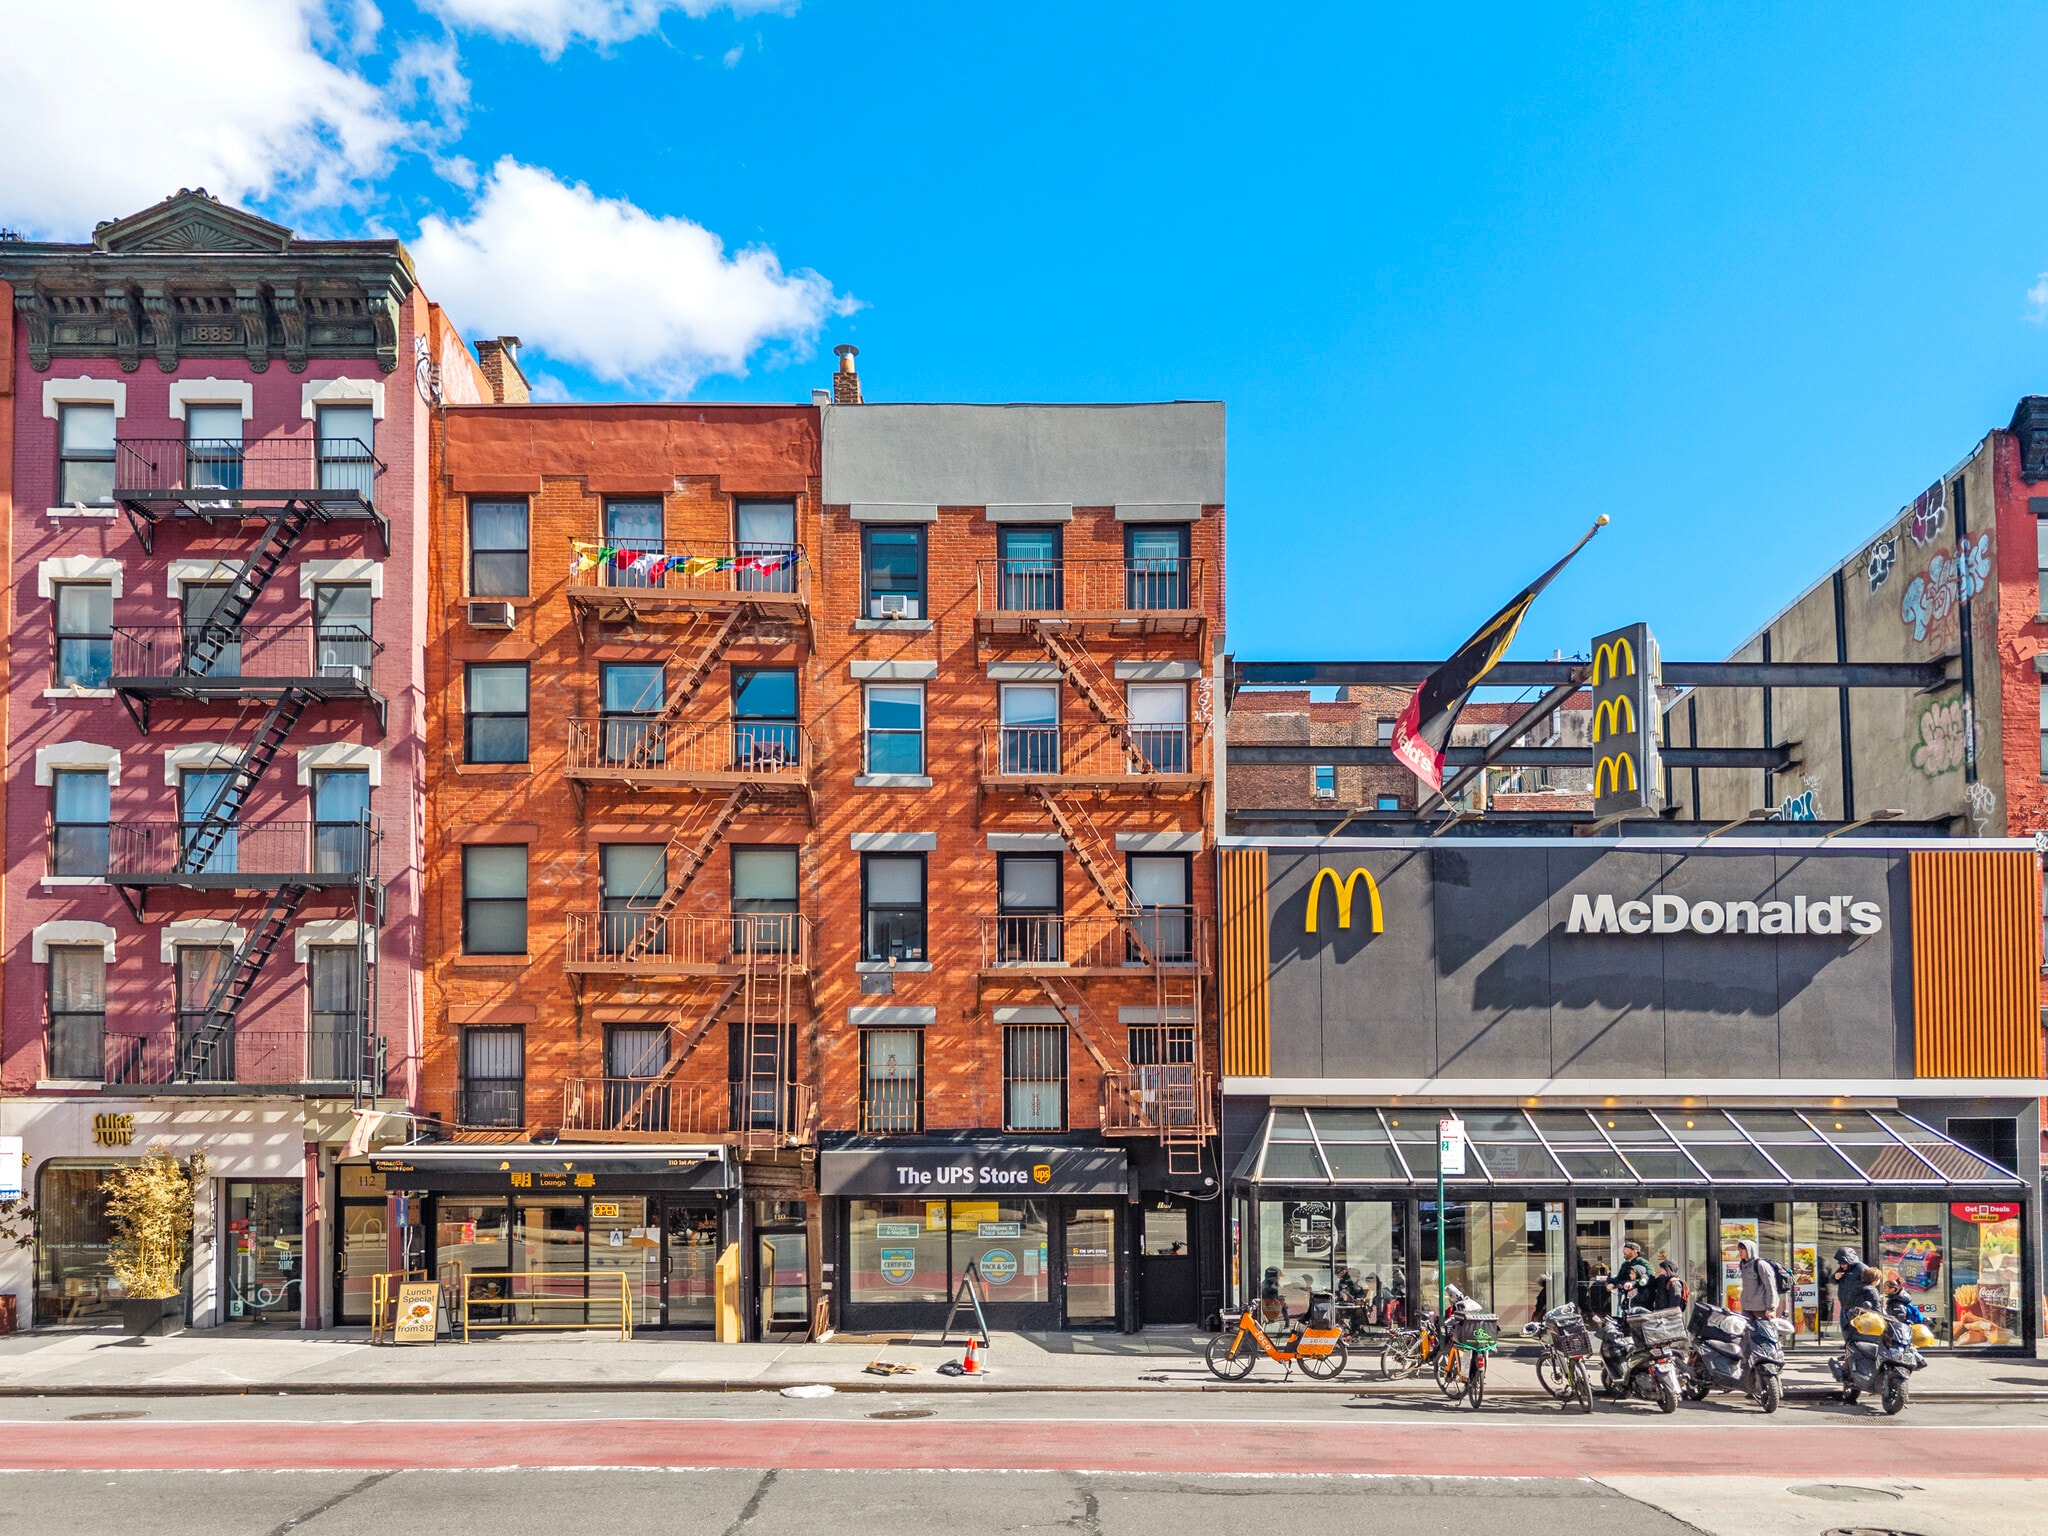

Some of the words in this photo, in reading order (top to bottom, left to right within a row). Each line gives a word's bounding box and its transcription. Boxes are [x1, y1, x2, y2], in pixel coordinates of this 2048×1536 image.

[192, 326, 233, 341] 1885
[1565, 894, 1883, 936] McDonald's
[359, 1175, 376, 1187] 112
[897, 1166, 932, 1185] The
[936, 1166, 975, 1185] UPS
[979, 1166, 1028, 1185] Store
[540, 1179, 567, 1187] Lounge
[594, 1205, 618, 1217] OPEN
[1550, 1214, 1560, 1226] A
[403, 1296, 434, 1304] Special
